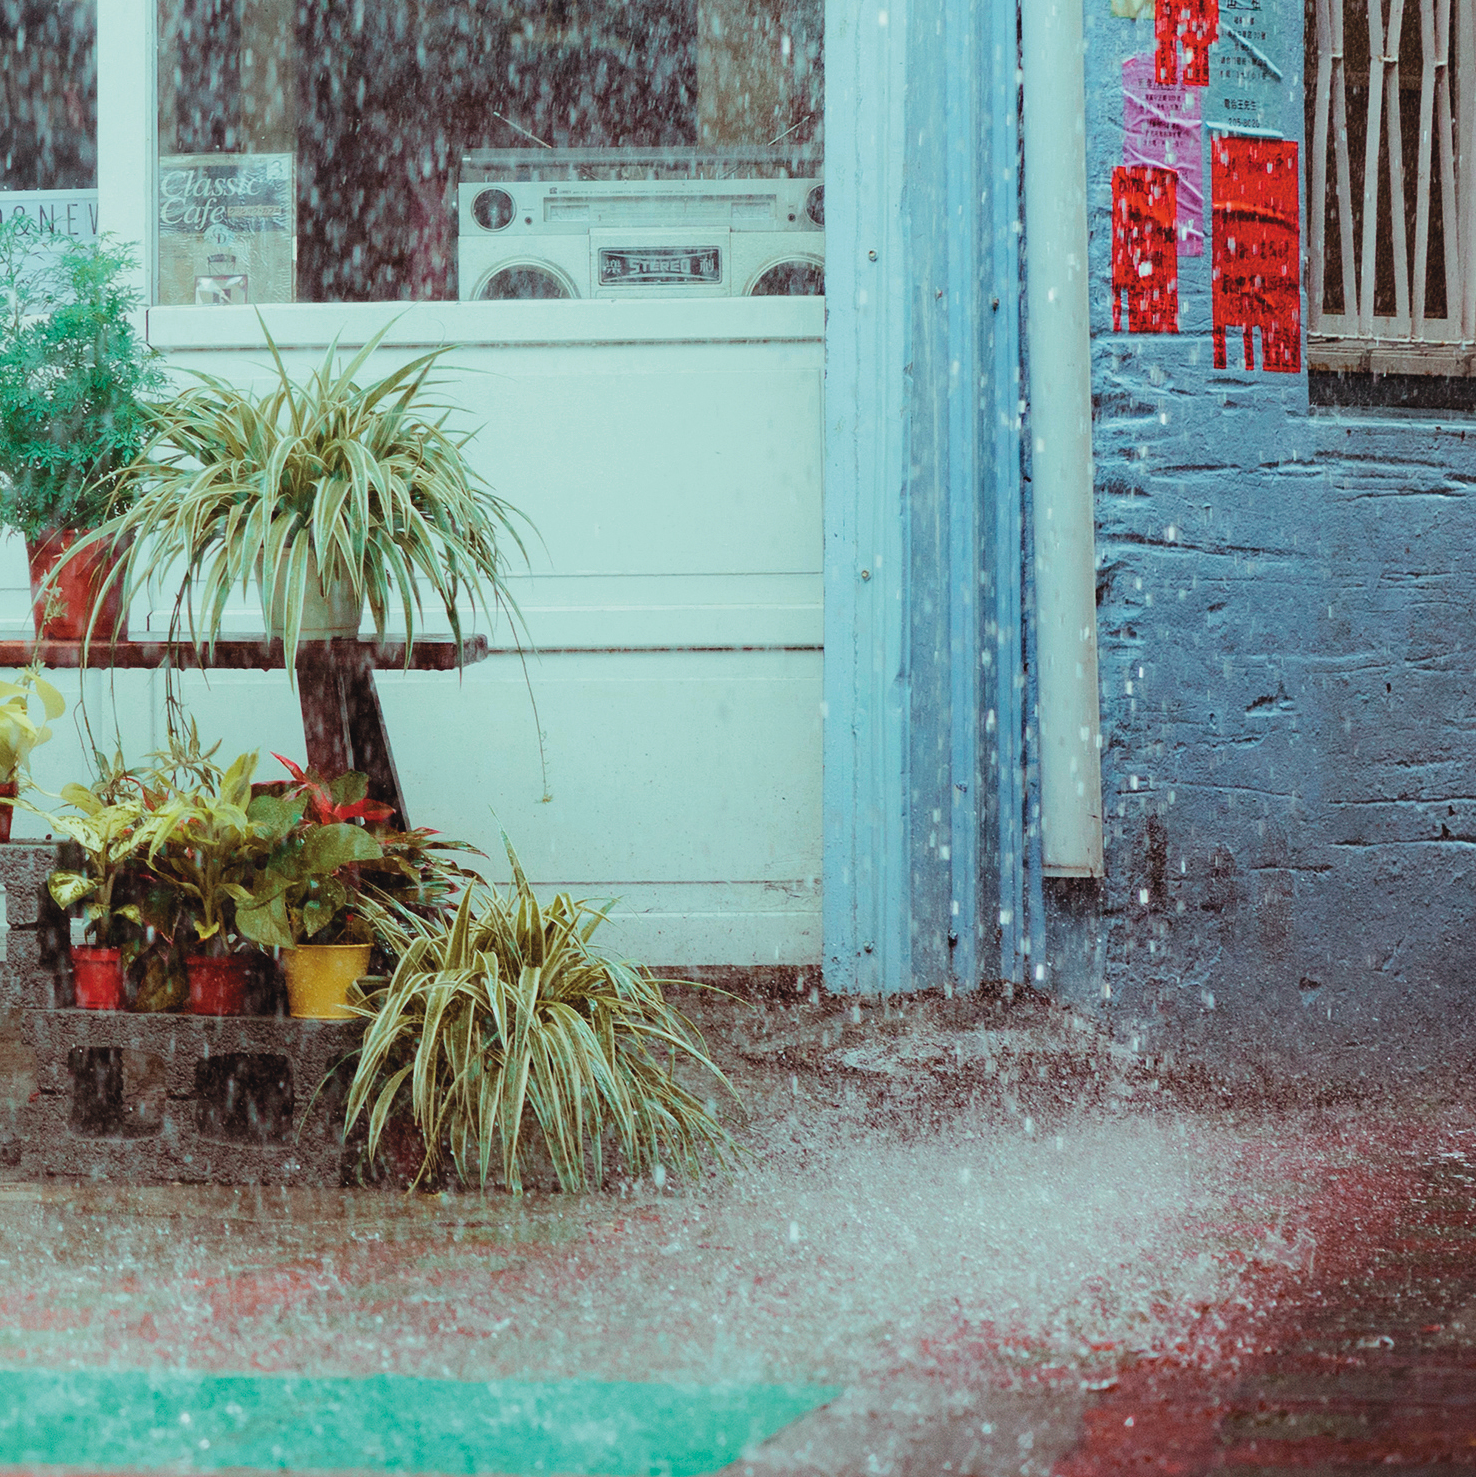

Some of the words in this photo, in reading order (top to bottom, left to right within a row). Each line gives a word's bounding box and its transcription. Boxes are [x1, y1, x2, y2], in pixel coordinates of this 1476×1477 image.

[160, 169, 262, 198] Classic
[160, 197, 227, 230] Cafe
[628, 258, 691, 274] STEREO
